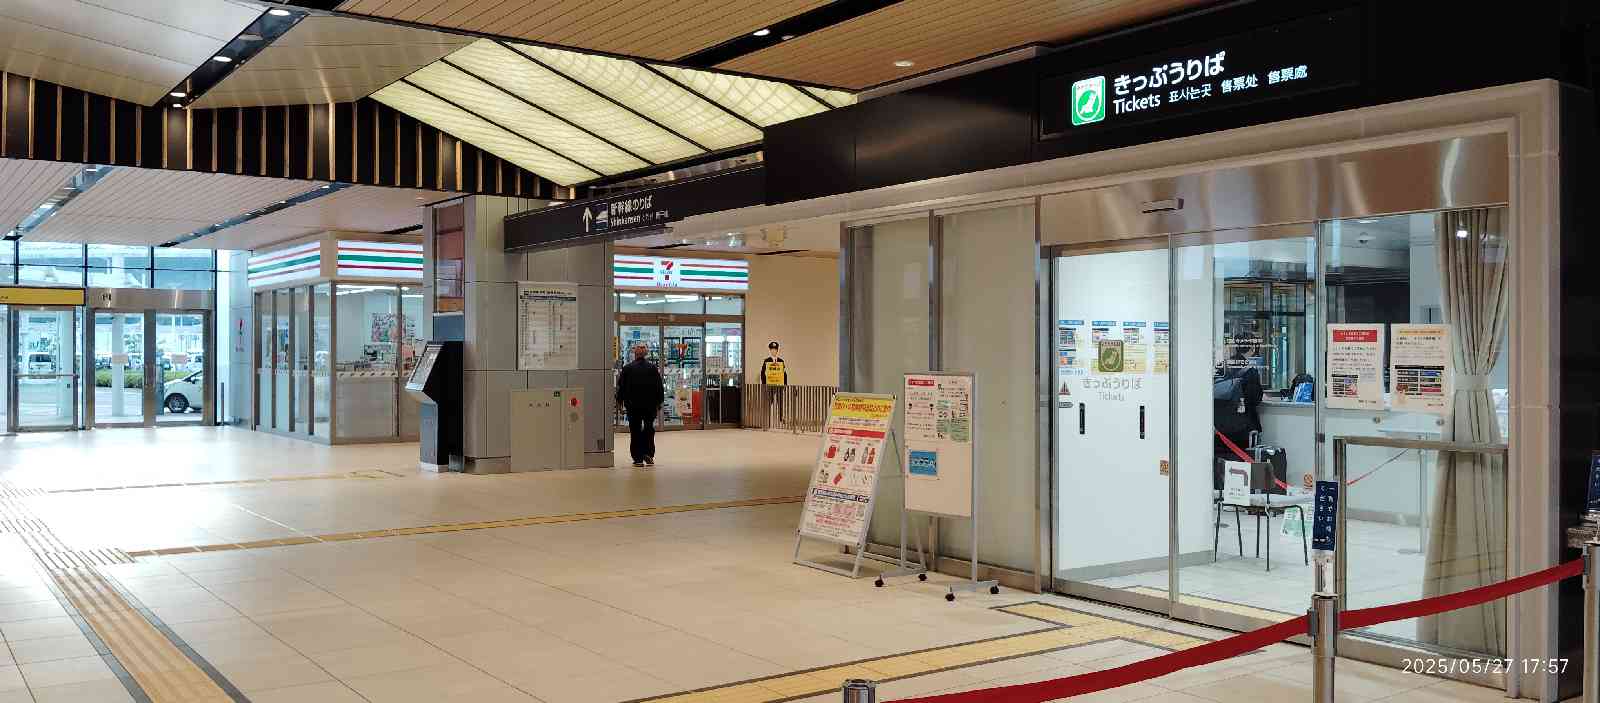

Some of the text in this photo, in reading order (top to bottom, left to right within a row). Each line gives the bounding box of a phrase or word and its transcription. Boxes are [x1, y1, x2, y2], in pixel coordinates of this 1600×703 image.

[1113, 50, 1226, 96] きっぷうりば
[1113, 93, 1161, 115] Tickets
[1168, 83, 1212, 103] 표사는곳
[1220, 74, 1259, 94] 售票处
[610, 195, 653, 216] 新幹線のりば
[610, 215, 641, 228] Shinkansen
[1080, 376, 1143, 390] きっぷうりば
